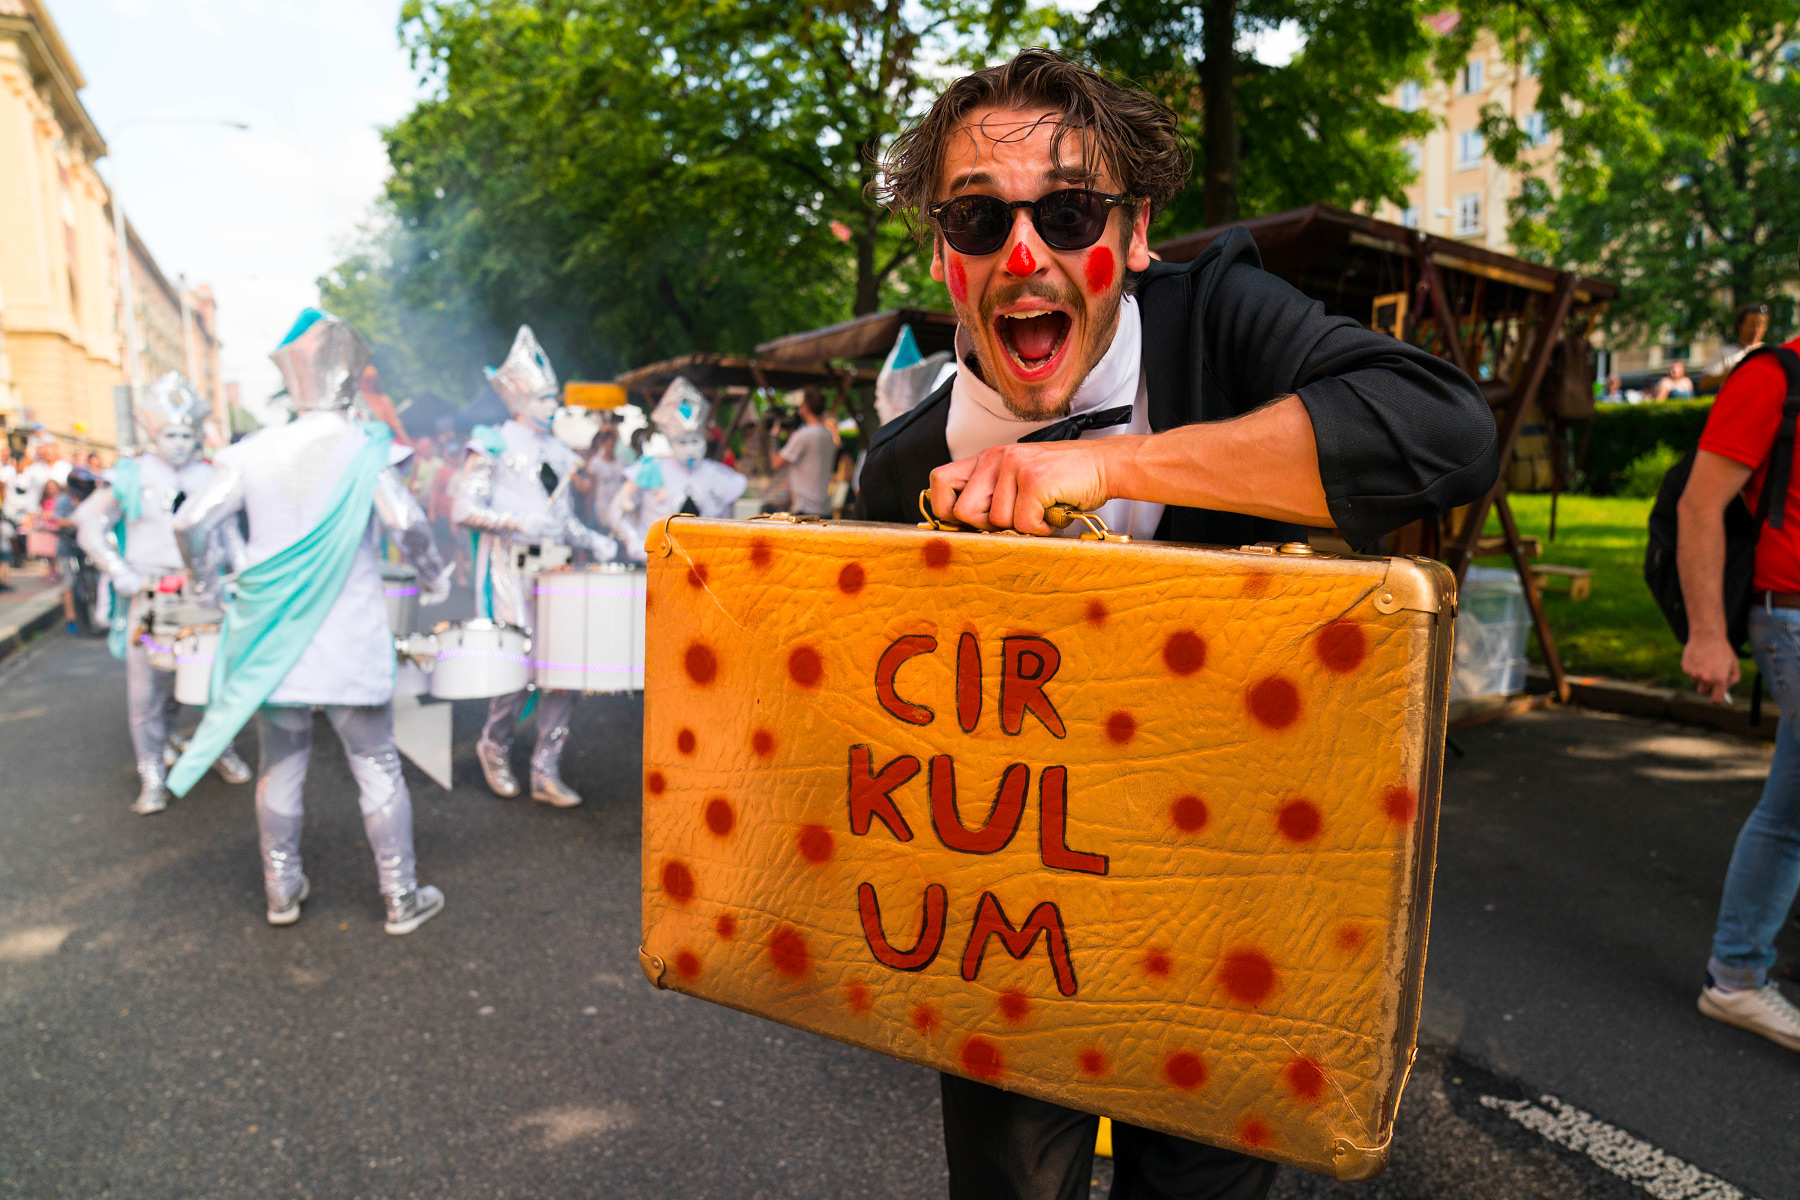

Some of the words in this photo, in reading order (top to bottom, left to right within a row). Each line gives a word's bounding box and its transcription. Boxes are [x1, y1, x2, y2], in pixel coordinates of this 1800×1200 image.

[876, 631, 1066, 739] CIR
[848, 744, 1109, 876] KUL
[857, 882, 1078, 997] UM
